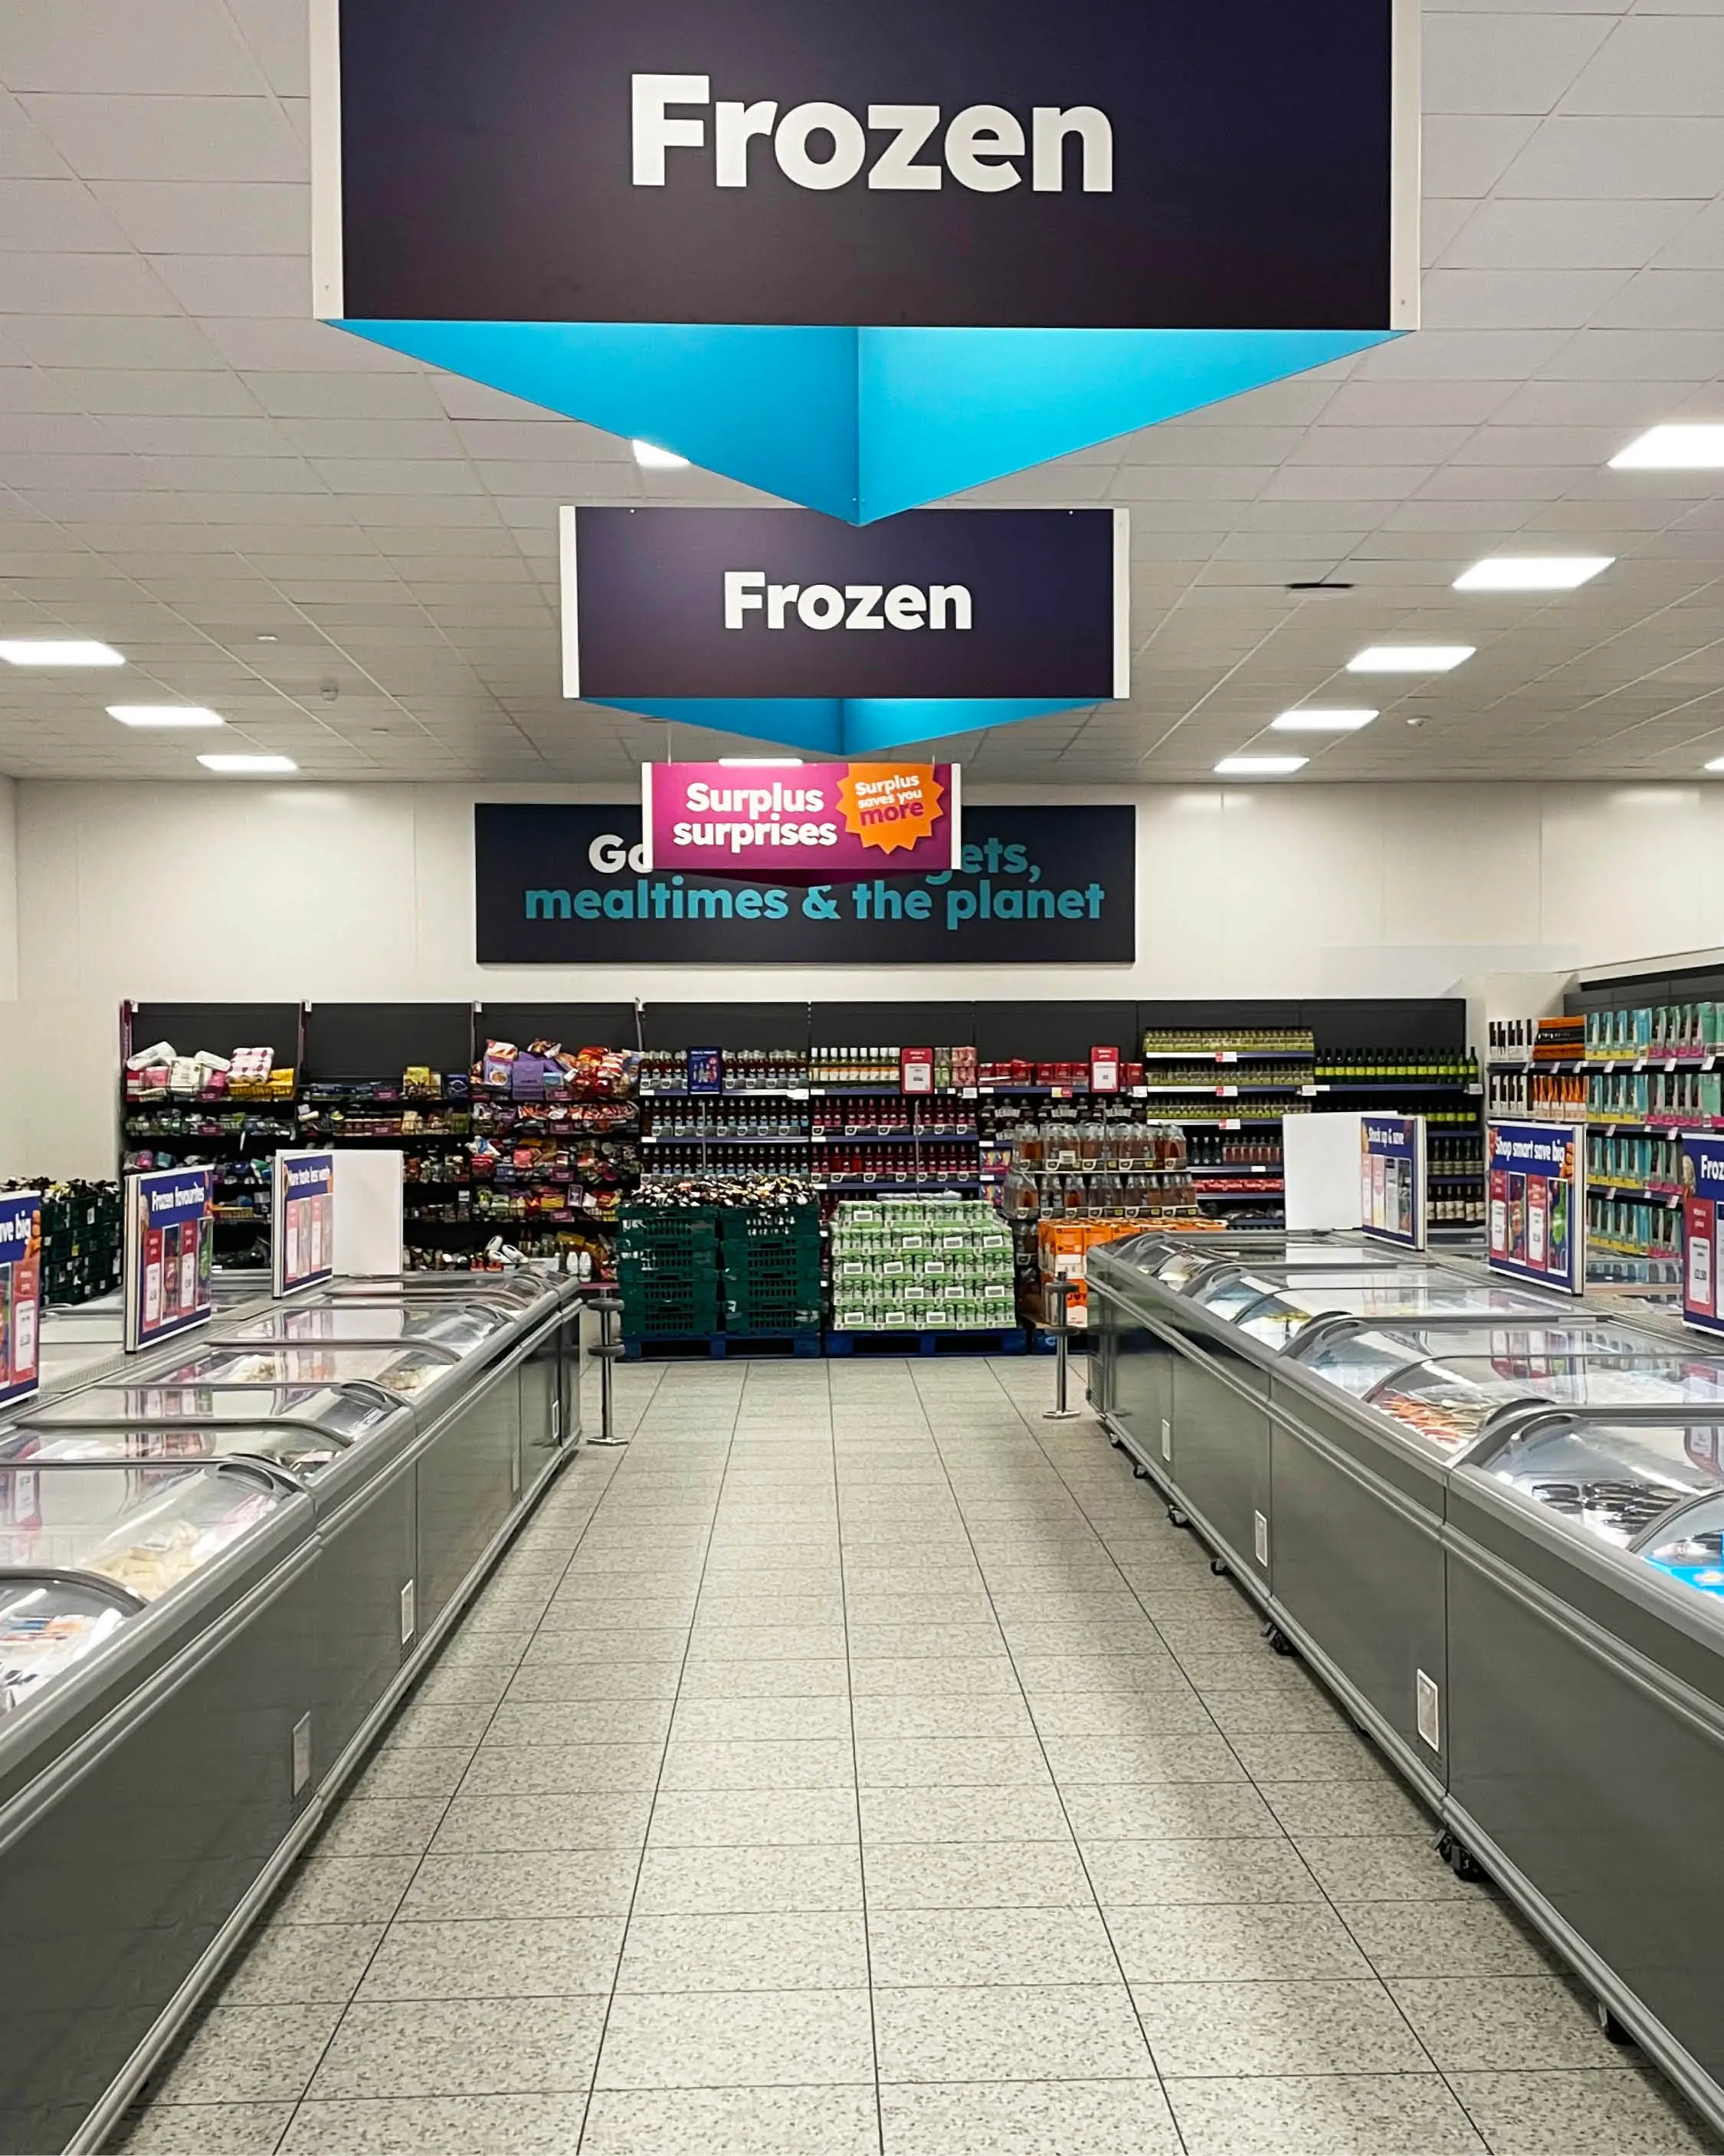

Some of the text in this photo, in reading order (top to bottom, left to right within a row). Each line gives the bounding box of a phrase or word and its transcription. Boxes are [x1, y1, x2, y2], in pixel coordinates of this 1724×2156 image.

[631, 74, 1113, 192] Frozen
[724, 571, 972, 630] Frozen
[686, 782, 824, 820] Surplus
[854, 775, 919, 796] Surplus
[857, 789, 923, 809] saves you
[860, 802, 924, 826] more
[673, 812, 837, 853] surprises
[525, 876, 1106, 930] mealtimes & the planet
[1495, 1135, 1565, 1168] Shop smart save big
[151, 1180, 205, 1213] Frozen favourites
[15, 1209, 32, 1245] big
